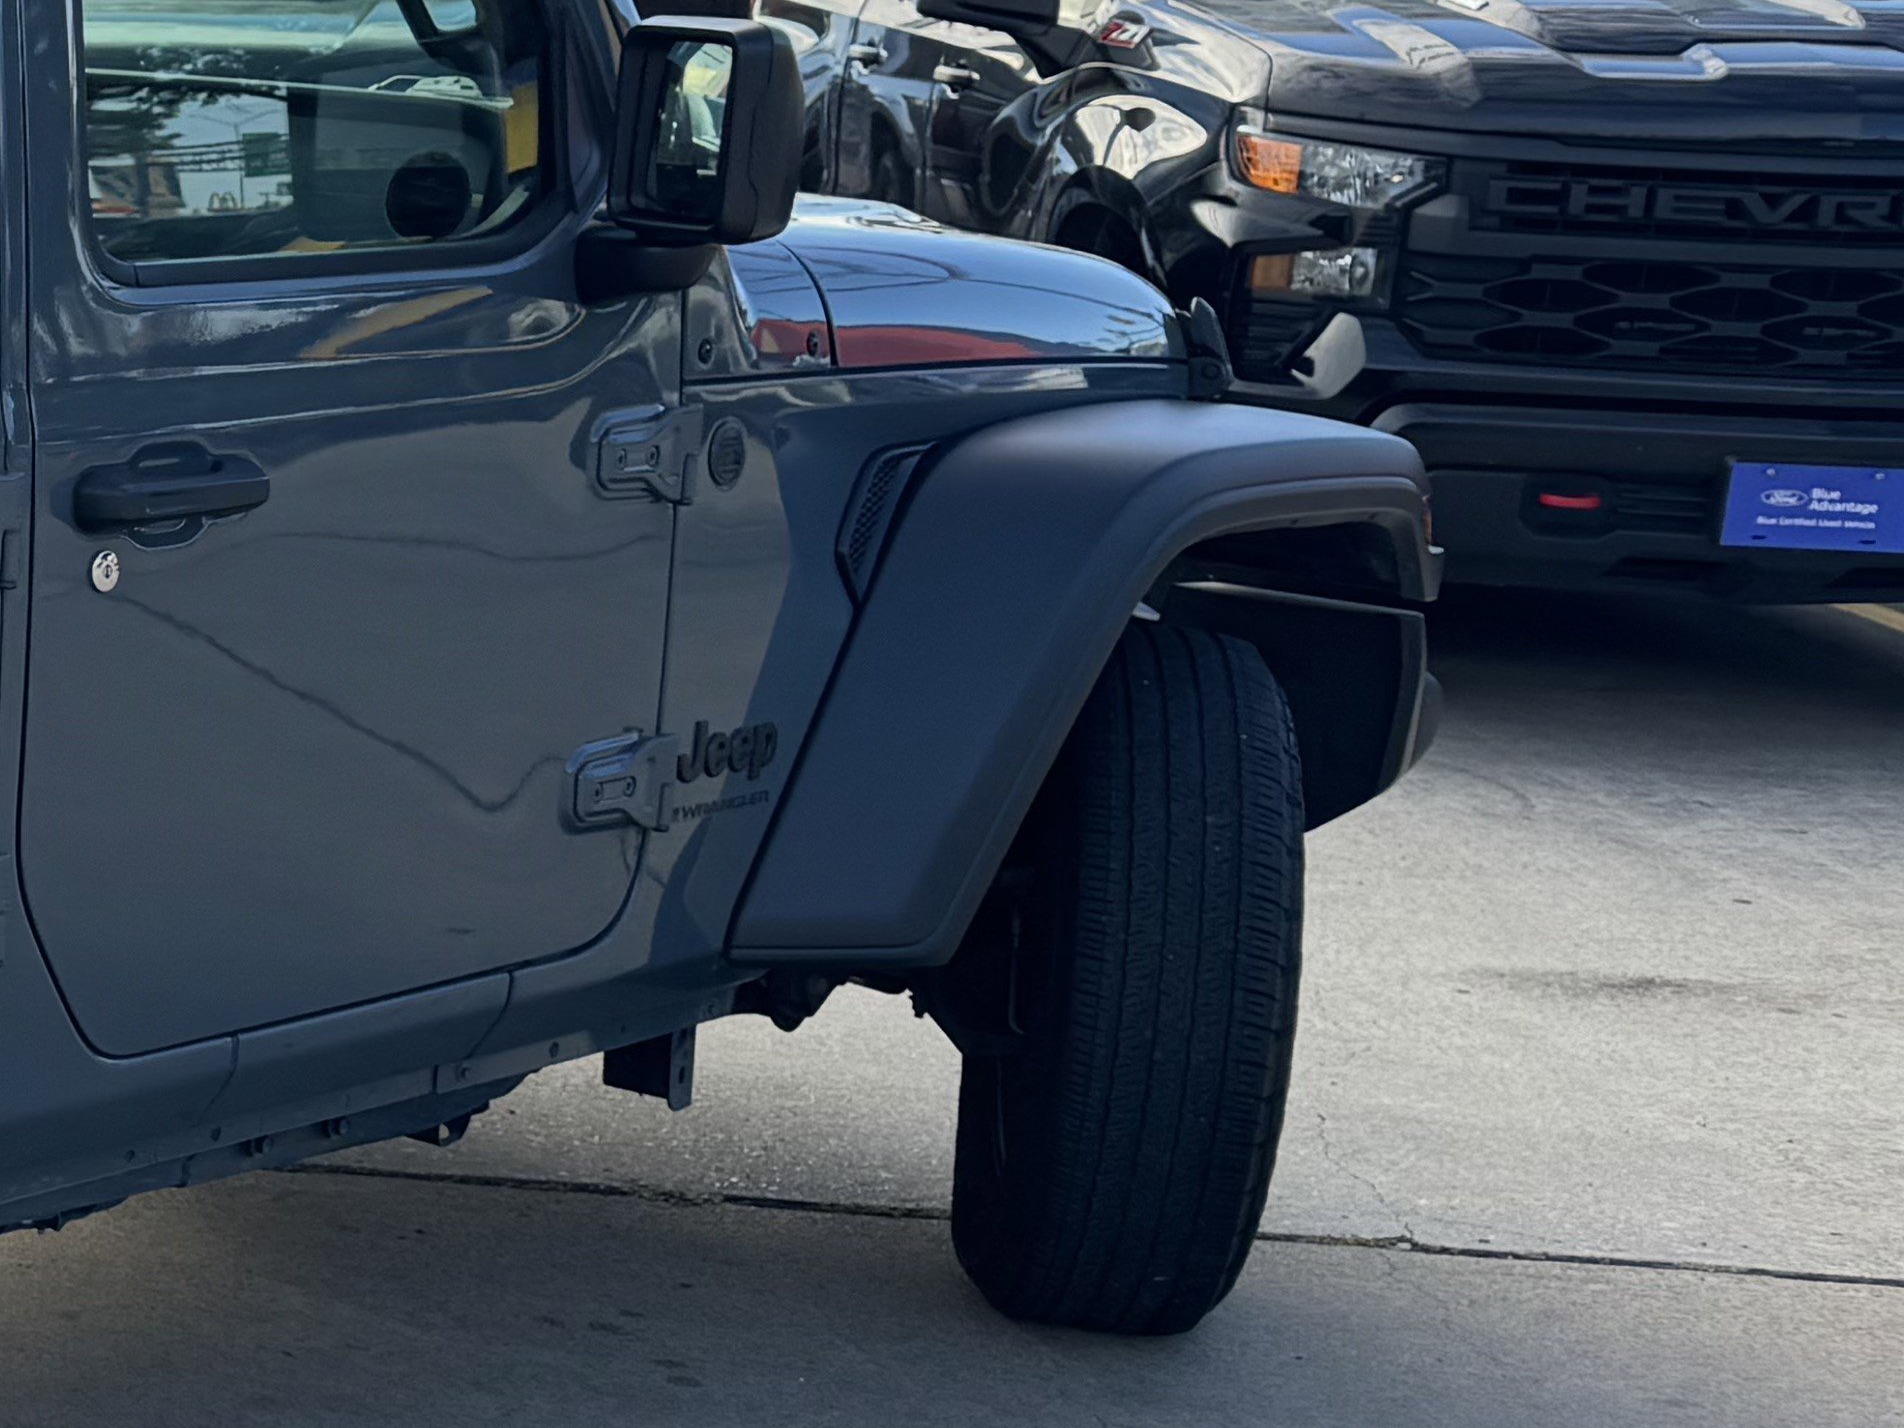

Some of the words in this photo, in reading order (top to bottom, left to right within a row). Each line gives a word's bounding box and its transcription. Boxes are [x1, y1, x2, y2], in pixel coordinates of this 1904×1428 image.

[1488, 179, 1904, 227] CHEVR
[1809, 501, 1878, 514] Advantage
[1812, 488, 1841, 500] Blue
[676, 721, 778, 784] Jeep
